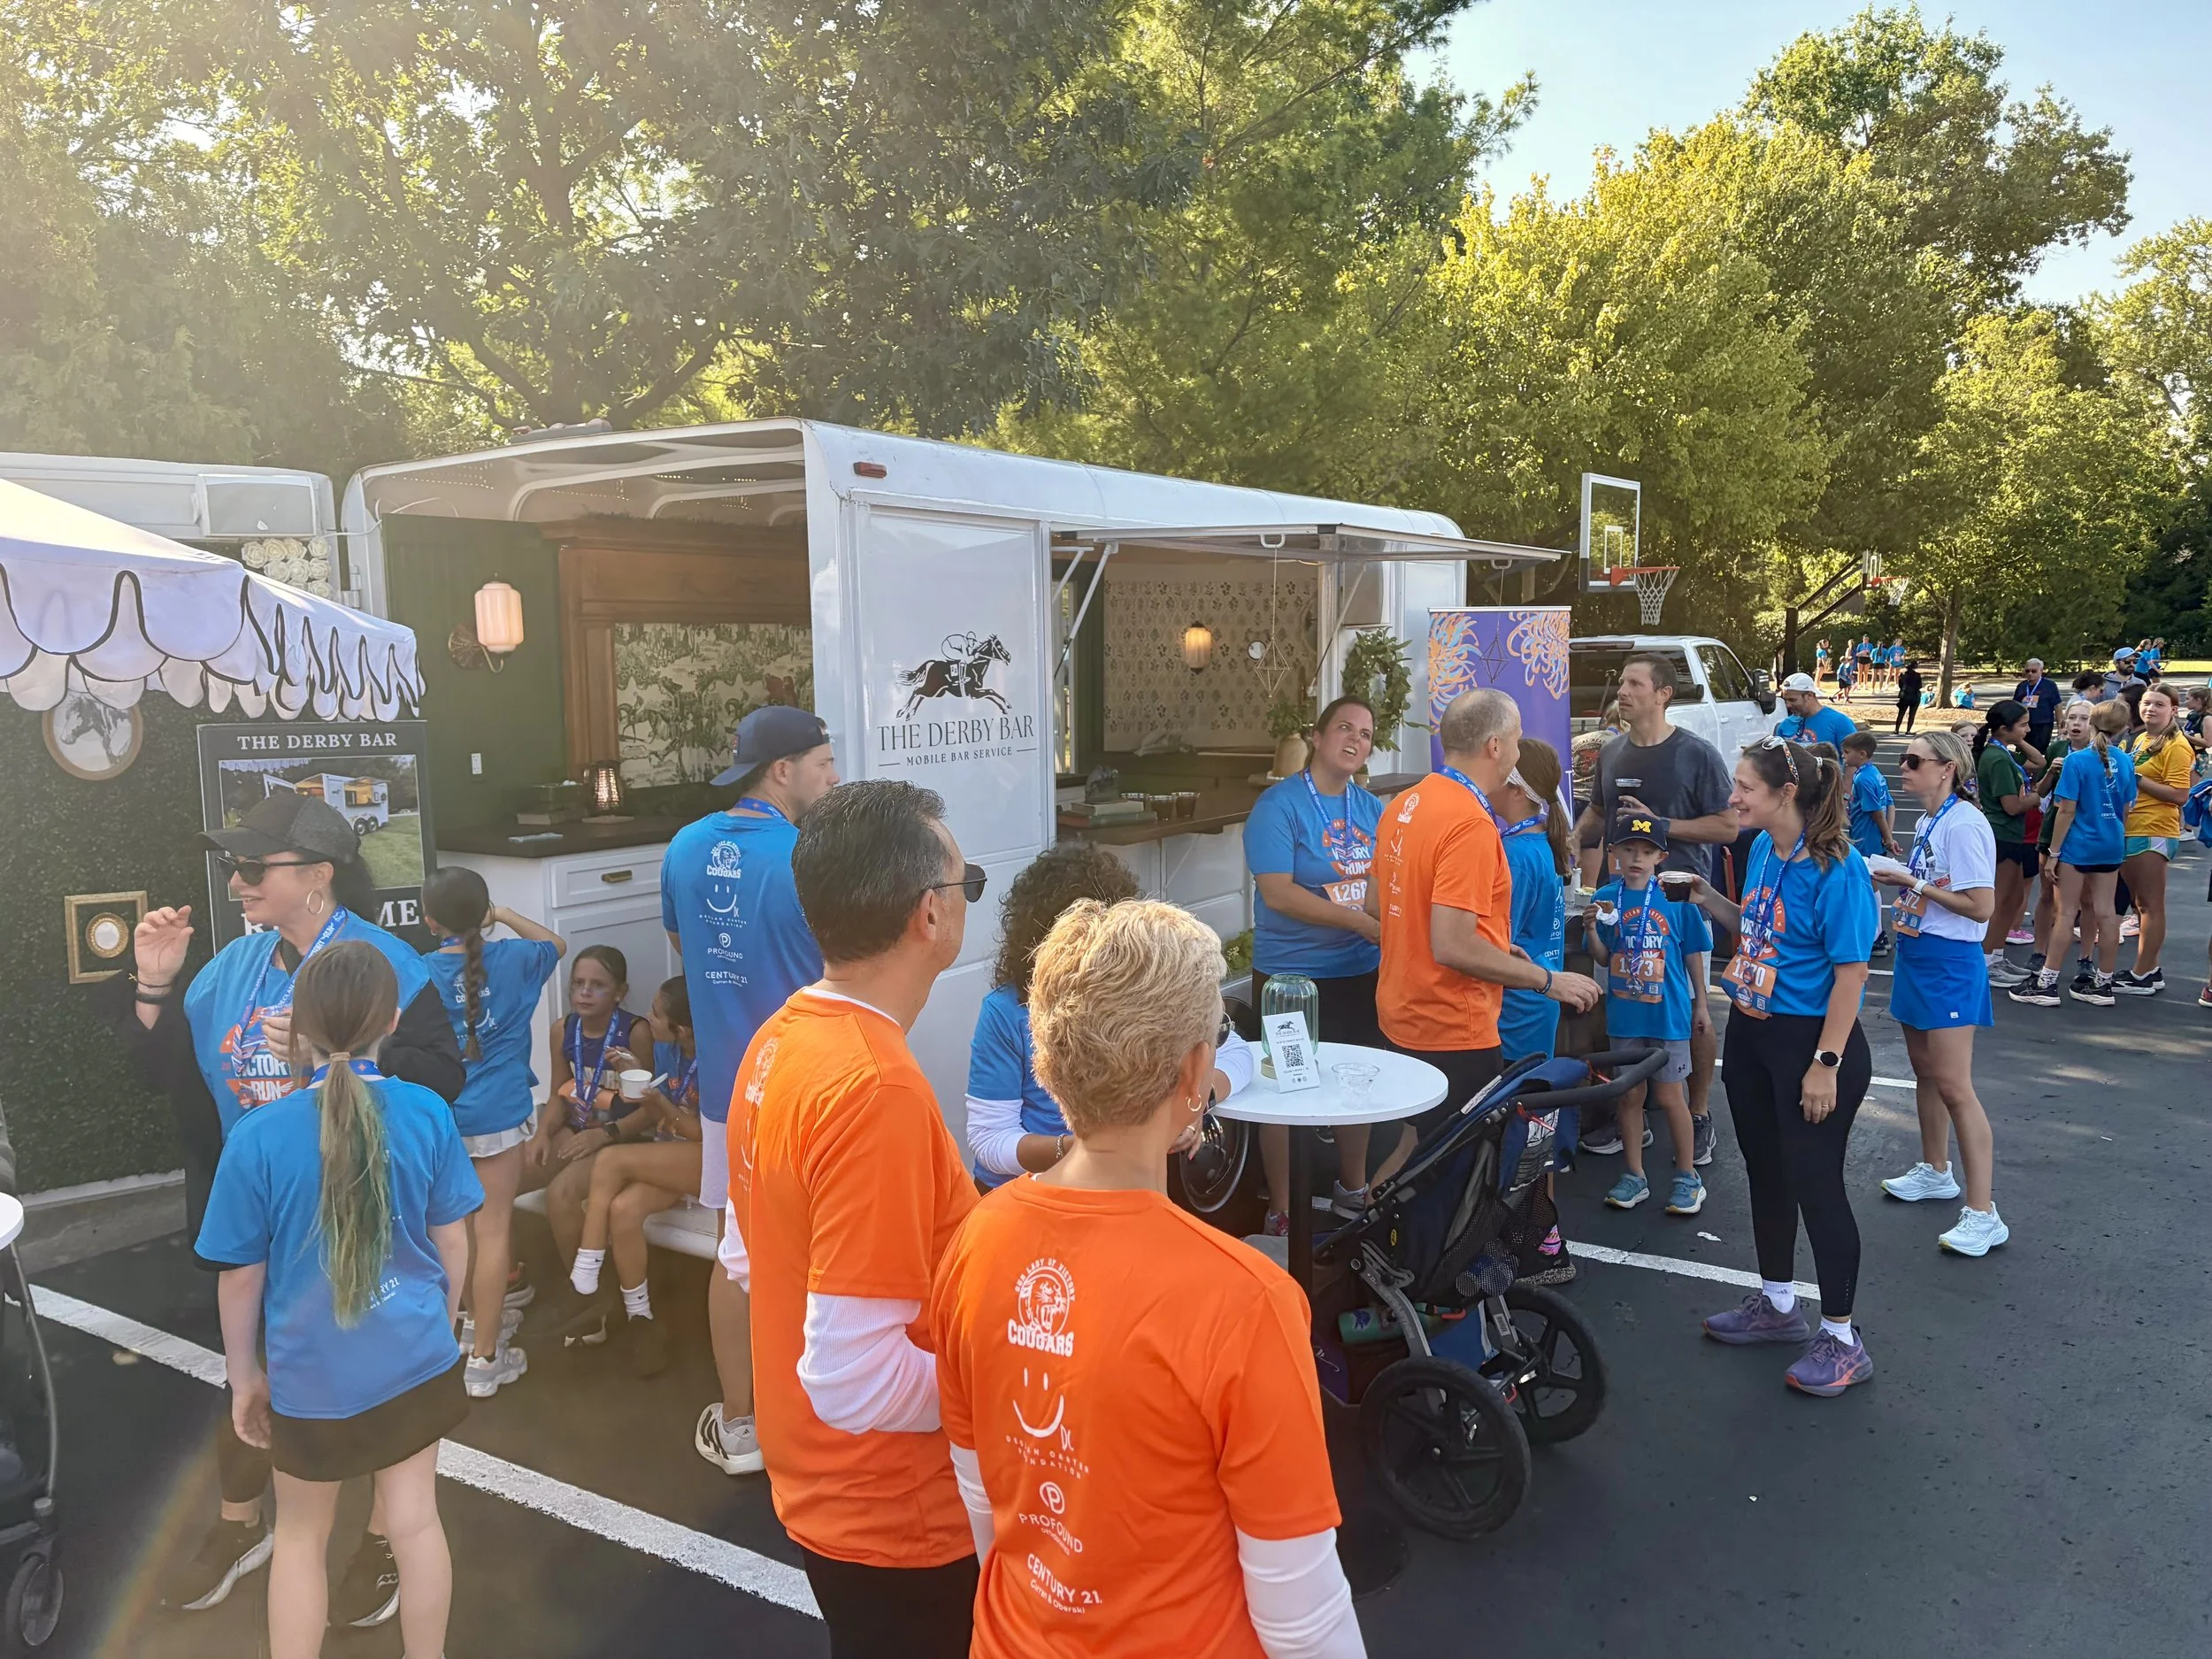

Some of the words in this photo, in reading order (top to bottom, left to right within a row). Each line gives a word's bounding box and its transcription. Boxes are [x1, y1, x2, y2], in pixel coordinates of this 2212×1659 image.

[237, 735, 280, 749] THE
[287, 733, 353, 749] DERBY
[359, 733, 397, 747] BAR
[877, 724, 922, 751] THE
[927, 718, 995, 747] DERBY
[1000, 715, 1034, 741] BAR
[906, 753, 947, 766] MOBILE
[951, 750, 970, 762] BAR
[974, 746, 1012, 759] SERVICE
[1631, 819, 1652, 833] M
[707, 864, 741, 879] COUGARS
[708, 948, 743, 959] PROFOUND
[705, 971, 740, 981] CENTURY
[250, 1080, 282, 1102] RUN
[1014, 1273, 1026, 1292] OUR
[1026, 1258, 1044, 1275] LADY
[1048, 1257, 1056, 1268] OF
[1007, 1318, 1074, 1357] COUGARS
[1018, 1513, 1083, 1553] PROFOUND
[1027, 1553, 1075, 1603] CENTURY
